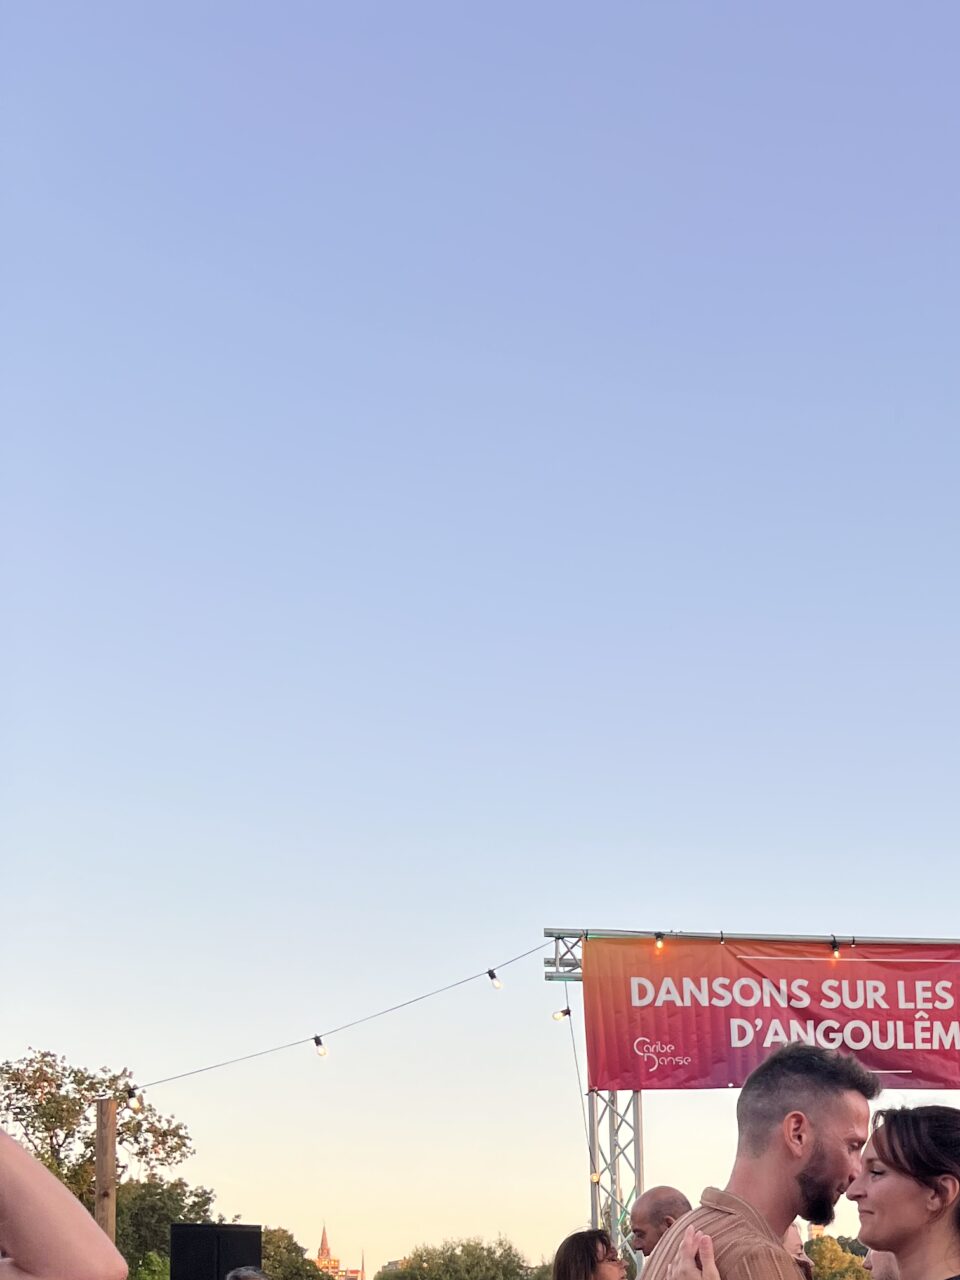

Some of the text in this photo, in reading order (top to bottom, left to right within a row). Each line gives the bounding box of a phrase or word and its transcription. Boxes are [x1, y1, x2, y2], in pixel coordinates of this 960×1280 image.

[630, 976, 810, 1009] DANSONS
[820, 979, 890, 1010] SUR
[897, 980, 954, 1011] LES
[633, 1036, 675, 1056] Caribe
[644, 1053, 692, 1072] Danse
